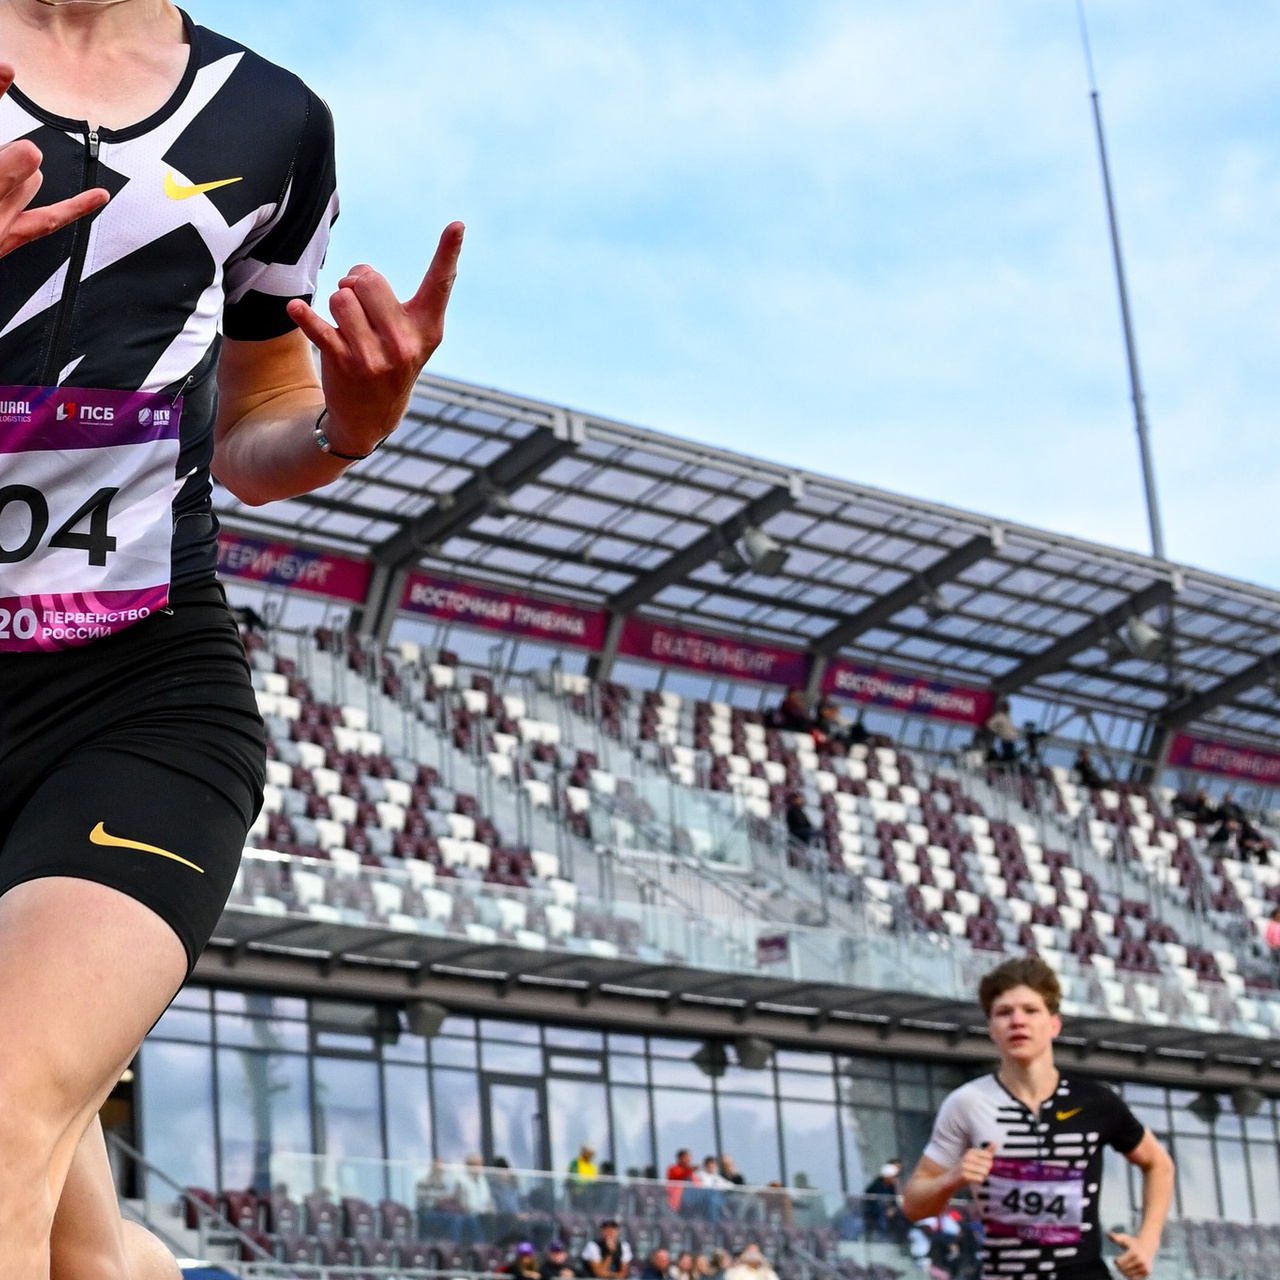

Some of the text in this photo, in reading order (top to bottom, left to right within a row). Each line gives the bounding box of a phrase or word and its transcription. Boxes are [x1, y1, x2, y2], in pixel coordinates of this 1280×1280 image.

[0, 401, 32, 415] URAL
[80, 406, 115, 421] ПСБ
[0, 415, 32, 423] LOGISTICS
[43, 607, 151, 625] ПЕРВЕНСТВО
[42, 626, 112, 640] РОССИИ
[1002, 1188, 1066, 1220] 494
